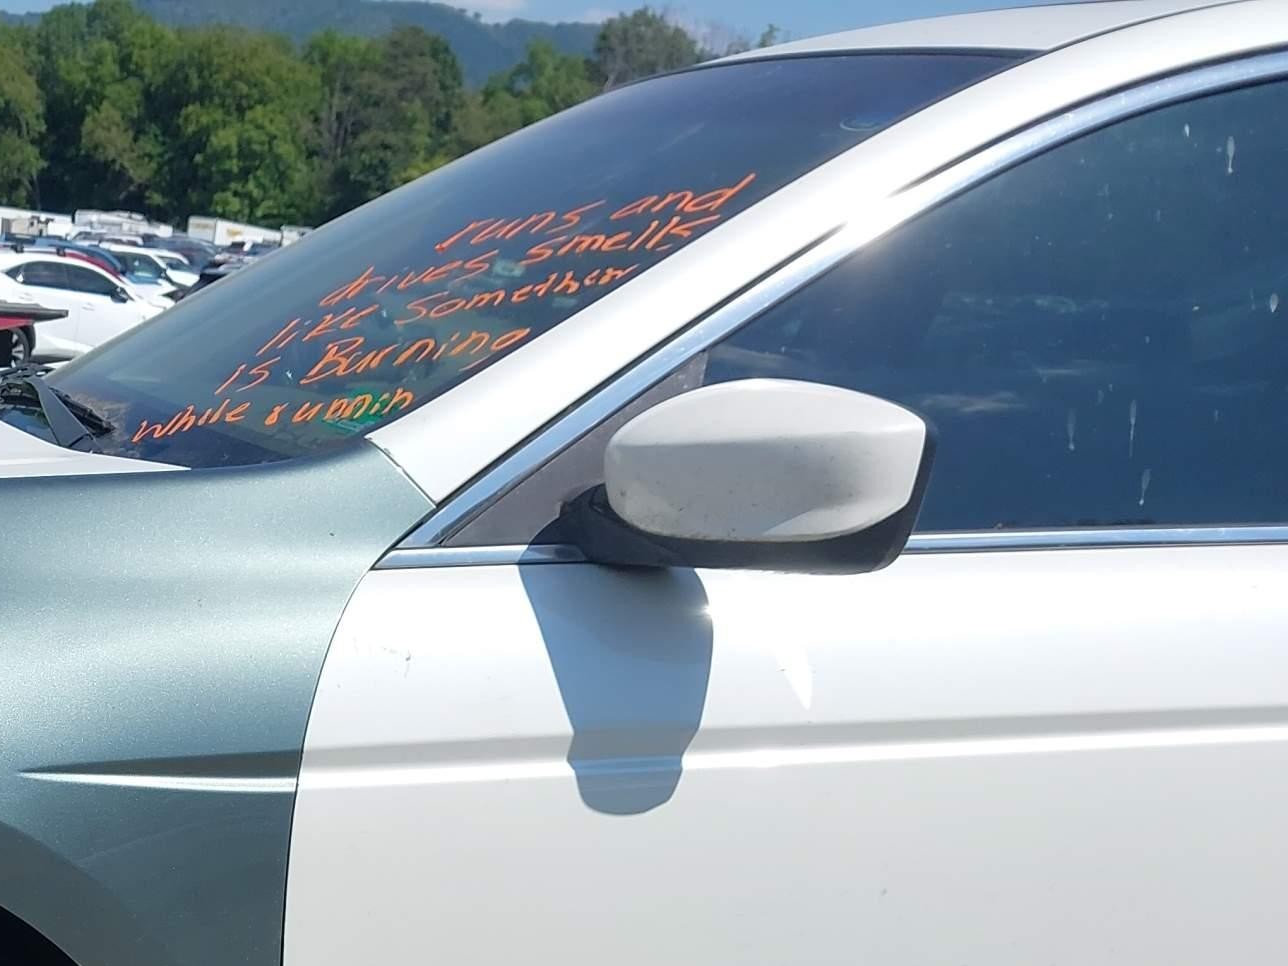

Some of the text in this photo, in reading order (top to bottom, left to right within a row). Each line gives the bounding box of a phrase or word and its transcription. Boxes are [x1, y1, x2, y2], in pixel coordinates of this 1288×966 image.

[435, 172, 757, 252] runs and
[320, 250, 499, 307] drives
